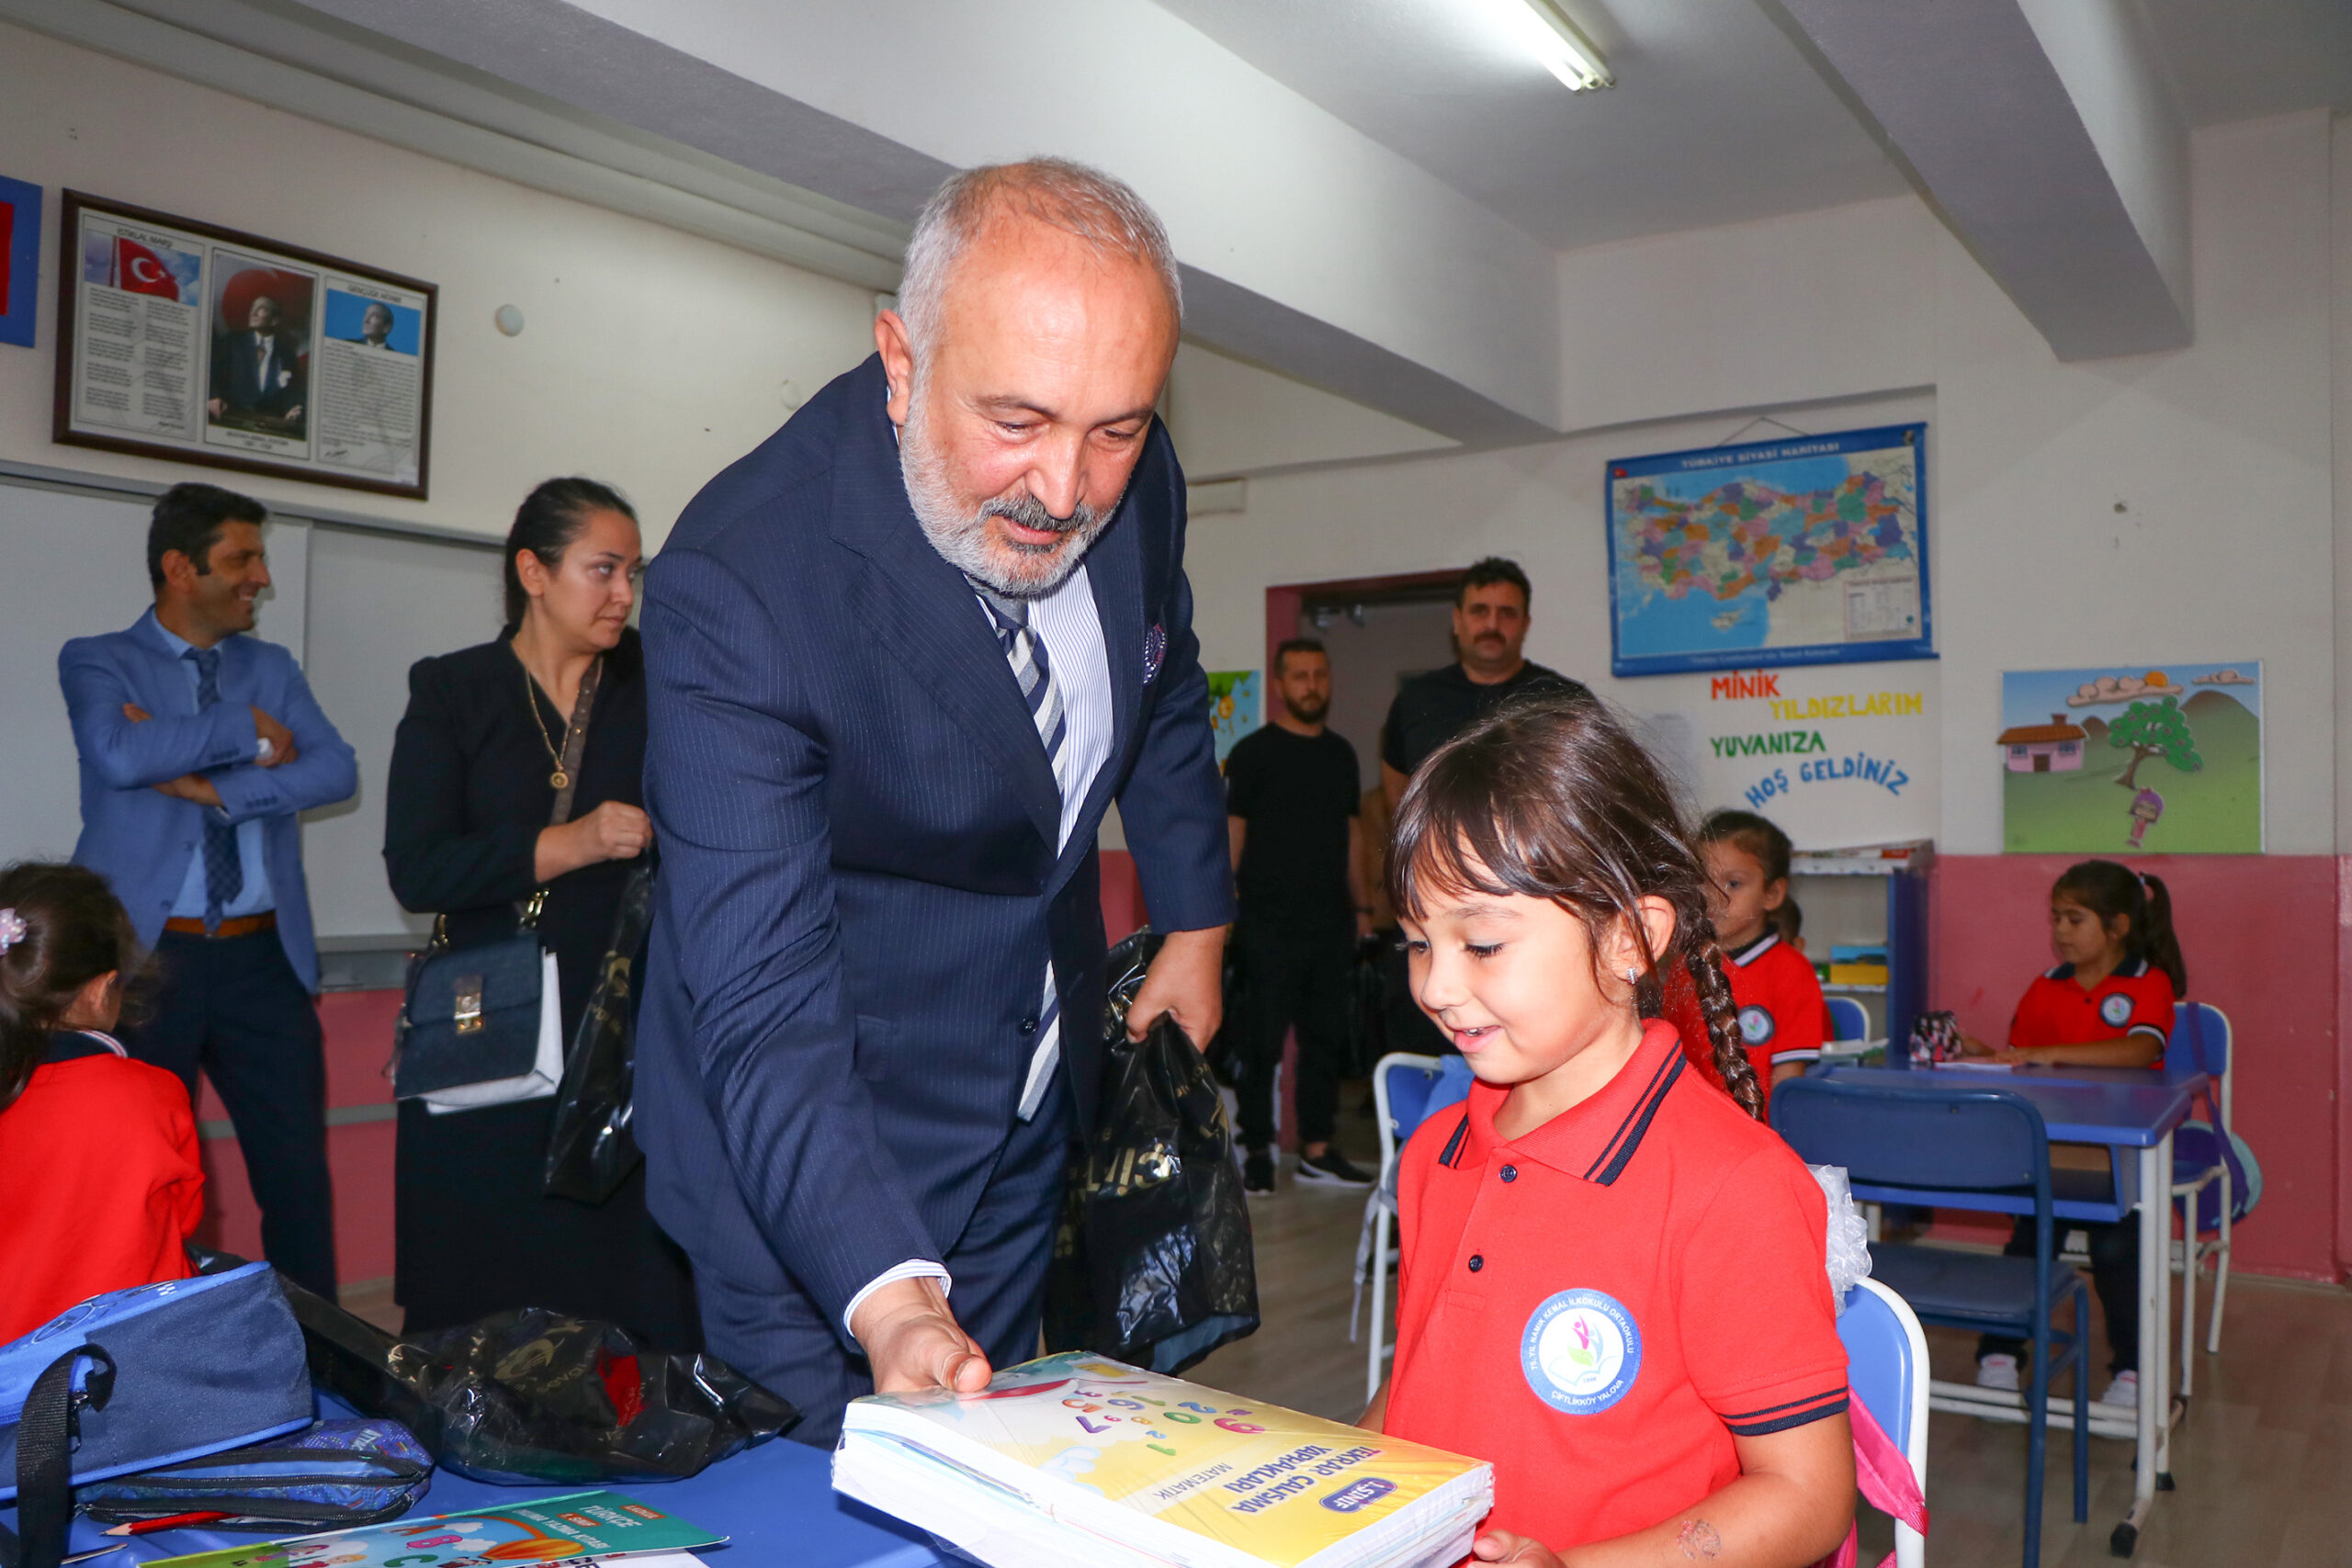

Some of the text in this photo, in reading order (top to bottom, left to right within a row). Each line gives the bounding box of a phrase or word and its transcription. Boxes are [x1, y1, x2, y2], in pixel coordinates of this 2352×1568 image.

[1681, 442, 1841, 469] TÜRKİYE SİYASİ HARİTASI
[1711, 669, 1781, 700] MİNİK
[1770, 692, 1923, 720] YILDIZLARIM
[1711, 730, 1826, 757] YUVANIZA
[1745, 751, 1909, 808] HOŞ GELDİNİZ
[1544, 1301, 1568, 1321] KEMAL
[1569, 1297, 1611, 1312] İLKOKULU
[1530, 1318, 1544, 1344] NAMIK
[1609, 1308, 1634, 1354] ORTAOKULU
[1528, 1344, 1537, 1357] YIL
[1551, 1379, 1624, 1406] ÇİFTLİKKÖY YALOVA
[1153, 1462, 1233, 1500] MATEMATİK
[1224, 1444, 1332, 1495] YAPRAKLARI
[1231, 1446, 1381, 1514] TEKRAR ÇALIŞMA
[579, 1505, 643, 1529] TÜRKÇE
